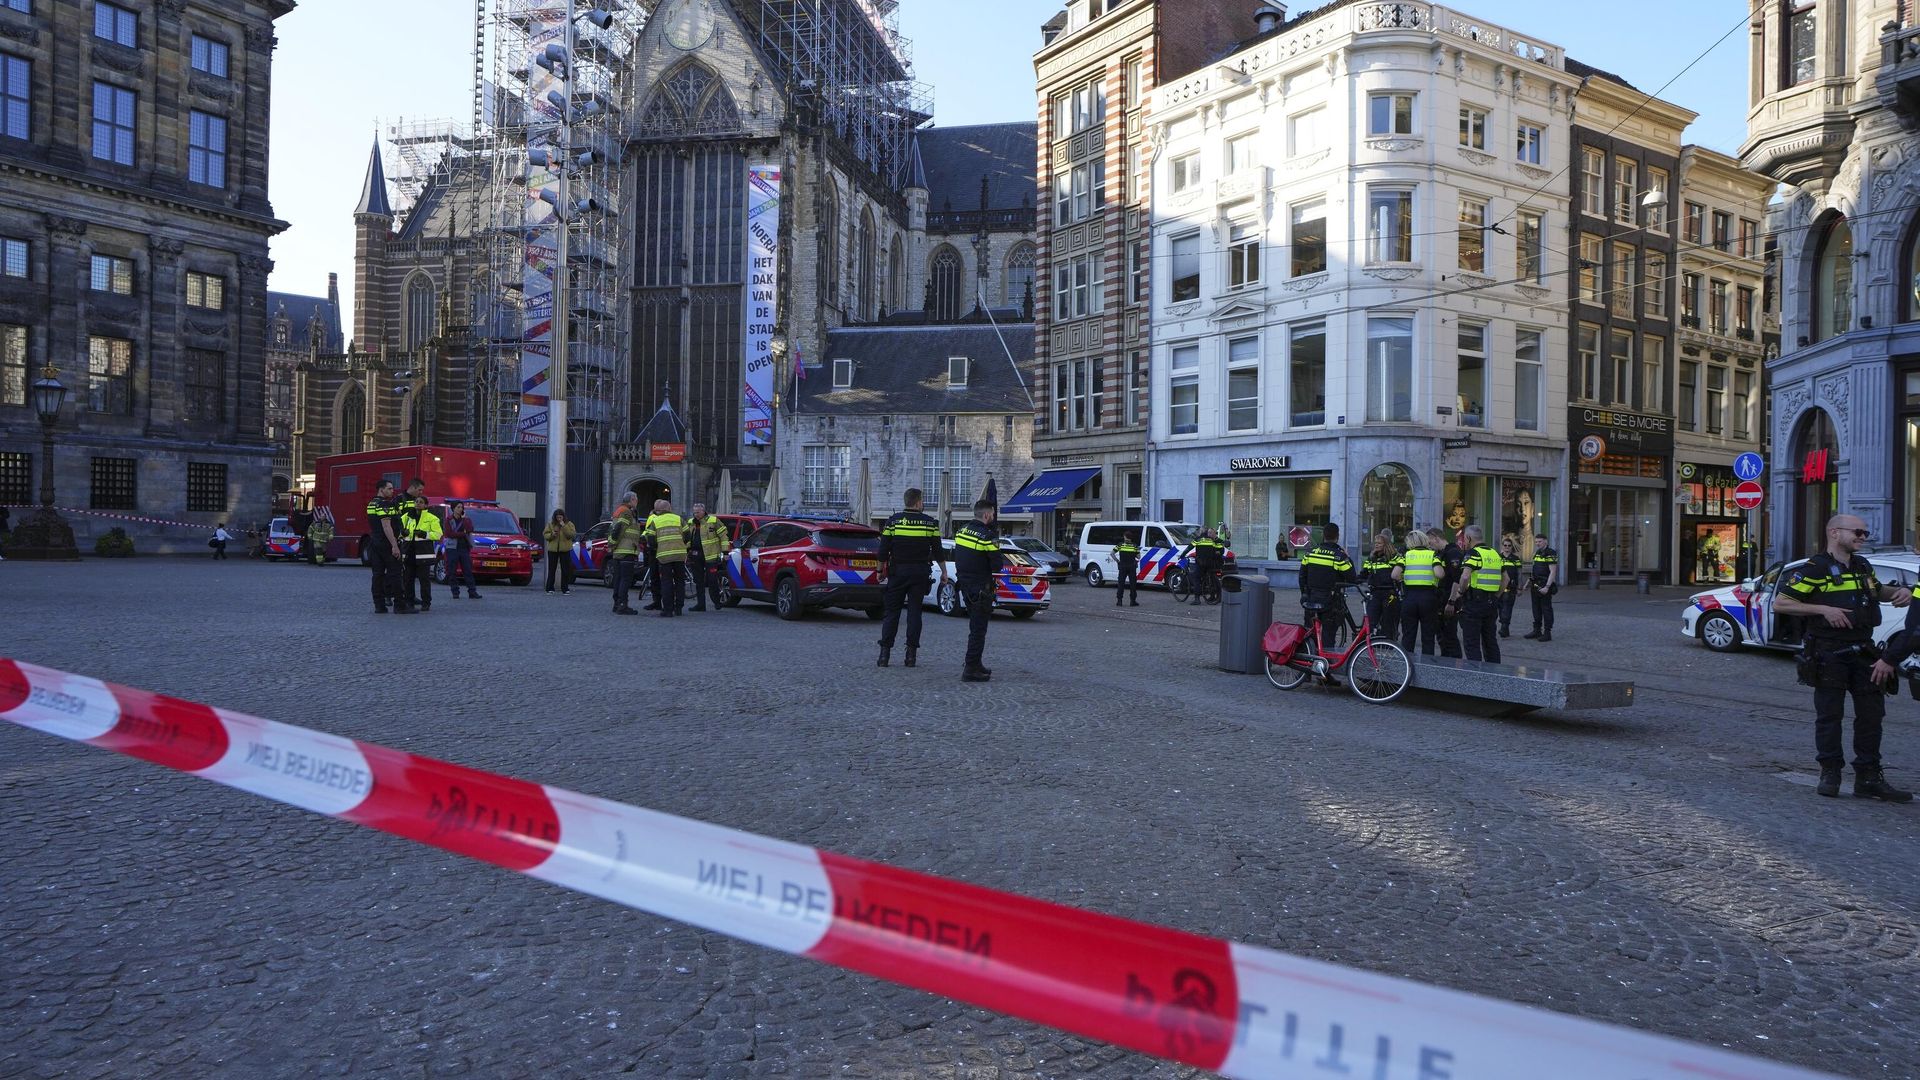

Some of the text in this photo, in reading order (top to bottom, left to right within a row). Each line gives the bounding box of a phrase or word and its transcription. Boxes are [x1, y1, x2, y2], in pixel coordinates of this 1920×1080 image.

[750, 221, 777, 255] HOERA
[753, 257, 773, 268] HET
[752, 274, 774, 285] DAK
[752, 291, 773, 302] VAN
[755, 307, 769, 318] DE
[748, 323, 775, 335] STAD
[756, 341, 767, 352] IS
[747, 353, 775, 373] OPEN
[534, 414, 546, 424] 750
[1584, 410, 1667, 431] CHEESE & MORE
[1231, 456, 1286, 469] SWAROVSKI
[1027, 487, 1063, 496] NAKED
